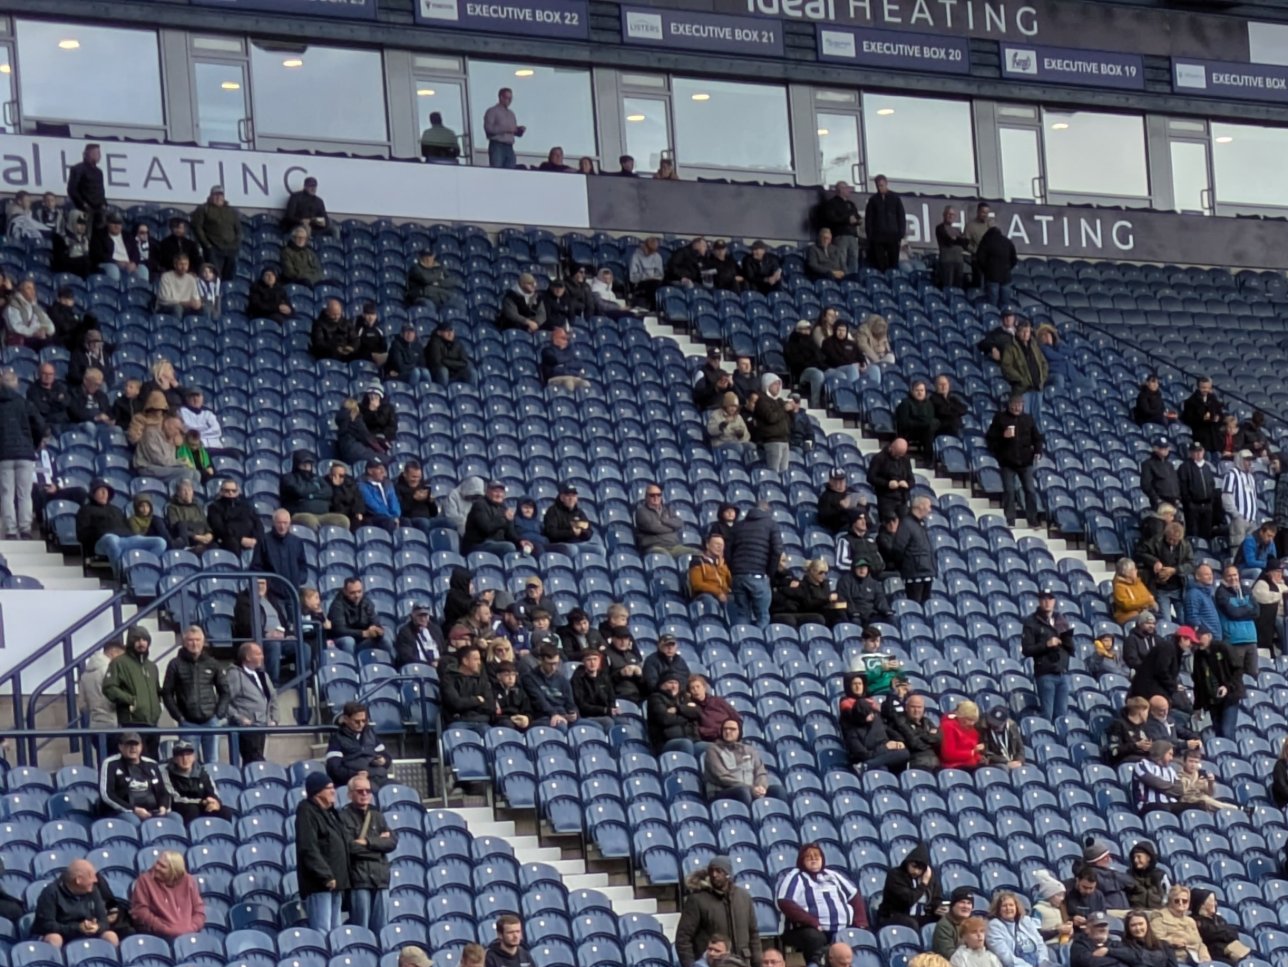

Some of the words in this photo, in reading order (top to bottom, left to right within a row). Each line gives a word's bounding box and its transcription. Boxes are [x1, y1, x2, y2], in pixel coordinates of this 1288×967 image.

[467, 3, 533, 21] EXECUTIVE
[535, 11, 562, 25] BOX
[564, 13, 579, 25] 22
[850, 0, 1038, 36] HEATING
[670, 22, 732, 39] EXECUTIVE
[735, 29, 759, 43] BOX
[762, 31, 774, 43] 21
[862, 41, 921, 57] EXECUTIVE
[923, 47, 946, 60] BOX
[948, 49, 962, 60] 20
[1044, 58, 1098, 73] EXECUTIVE
[1101, 63, 1122, 76] BOX
[1124, 65, 1137, 77] 19
[1212, 72, 1264, 88] EXECUTIVE
[1266, 78, 1287, 90] BOX
[951, 210, 1134, 250] HATING
